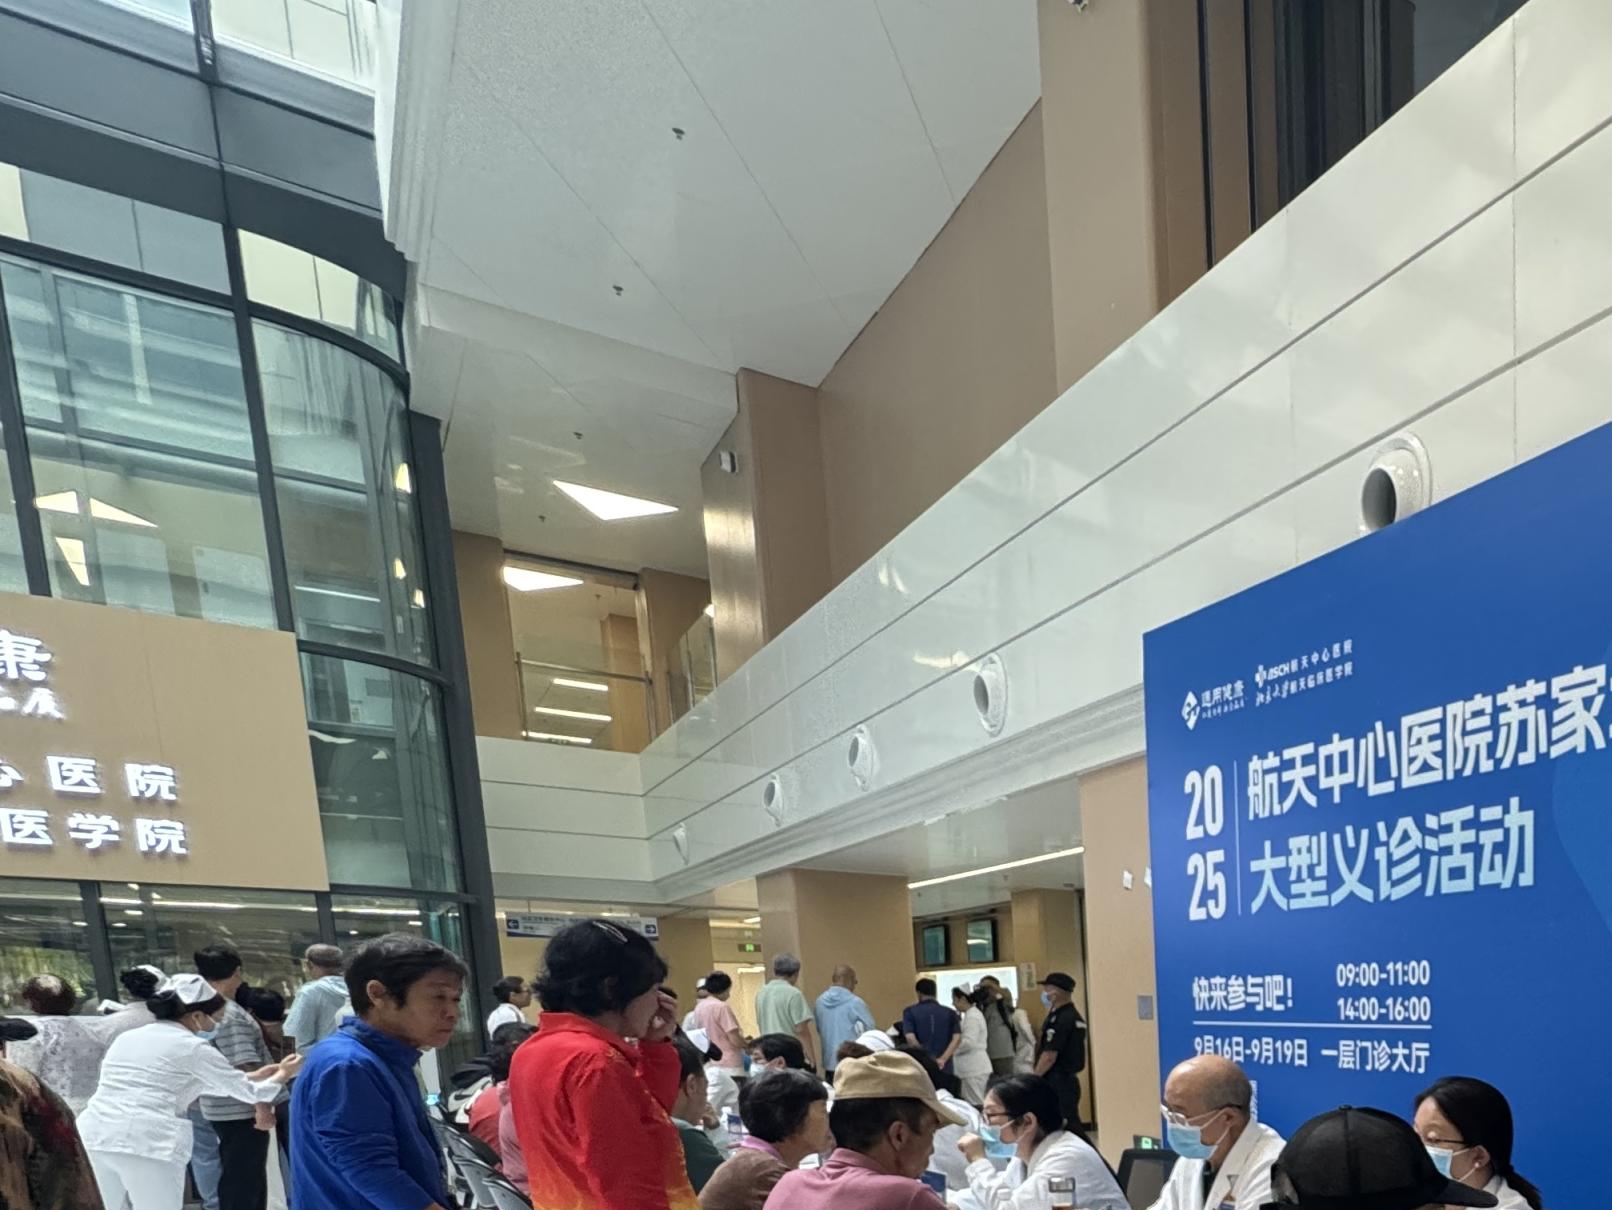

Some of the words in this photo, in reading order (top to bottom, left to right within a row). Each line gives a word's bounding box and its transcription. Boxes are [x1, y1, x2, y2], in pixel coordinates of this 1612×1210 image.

[1184, 763, 1225, 840] 20
[1249, 795, 1536, 915] 大型义诊活动
[1186, 848, 1227, 922] 25
[1335, 959, 1431, 988] 09:00-11:00
[1336, 995, 1432, 1022] 14:00-16:00
[1319, 1038, 1431, 1074] 一层门诊大厅
